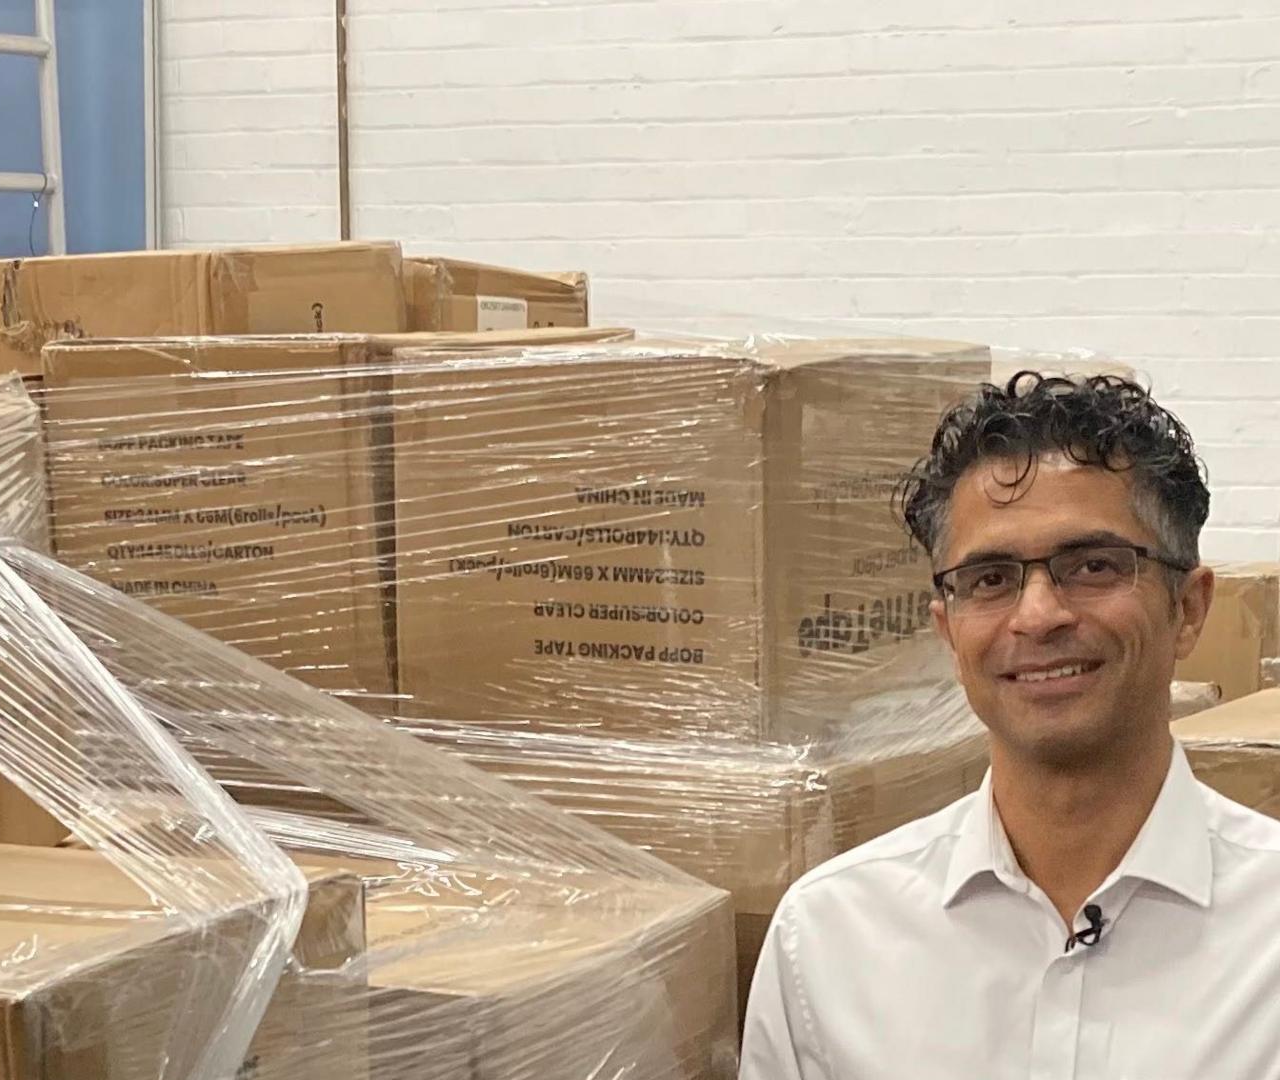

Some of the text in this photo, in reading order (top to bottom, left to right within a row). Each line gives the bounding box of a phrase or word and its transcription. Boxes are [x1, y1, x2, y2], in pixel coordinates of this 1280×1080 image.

[138, 435, 204, 450] PACKING
[575, 487, 706, 507] MADE IN CHINA
[598, 565, 611, 581] X
[534, 601, 586, 620] CLEAR
[535, 639, 704, 665] BOPP PACKING TAPE
